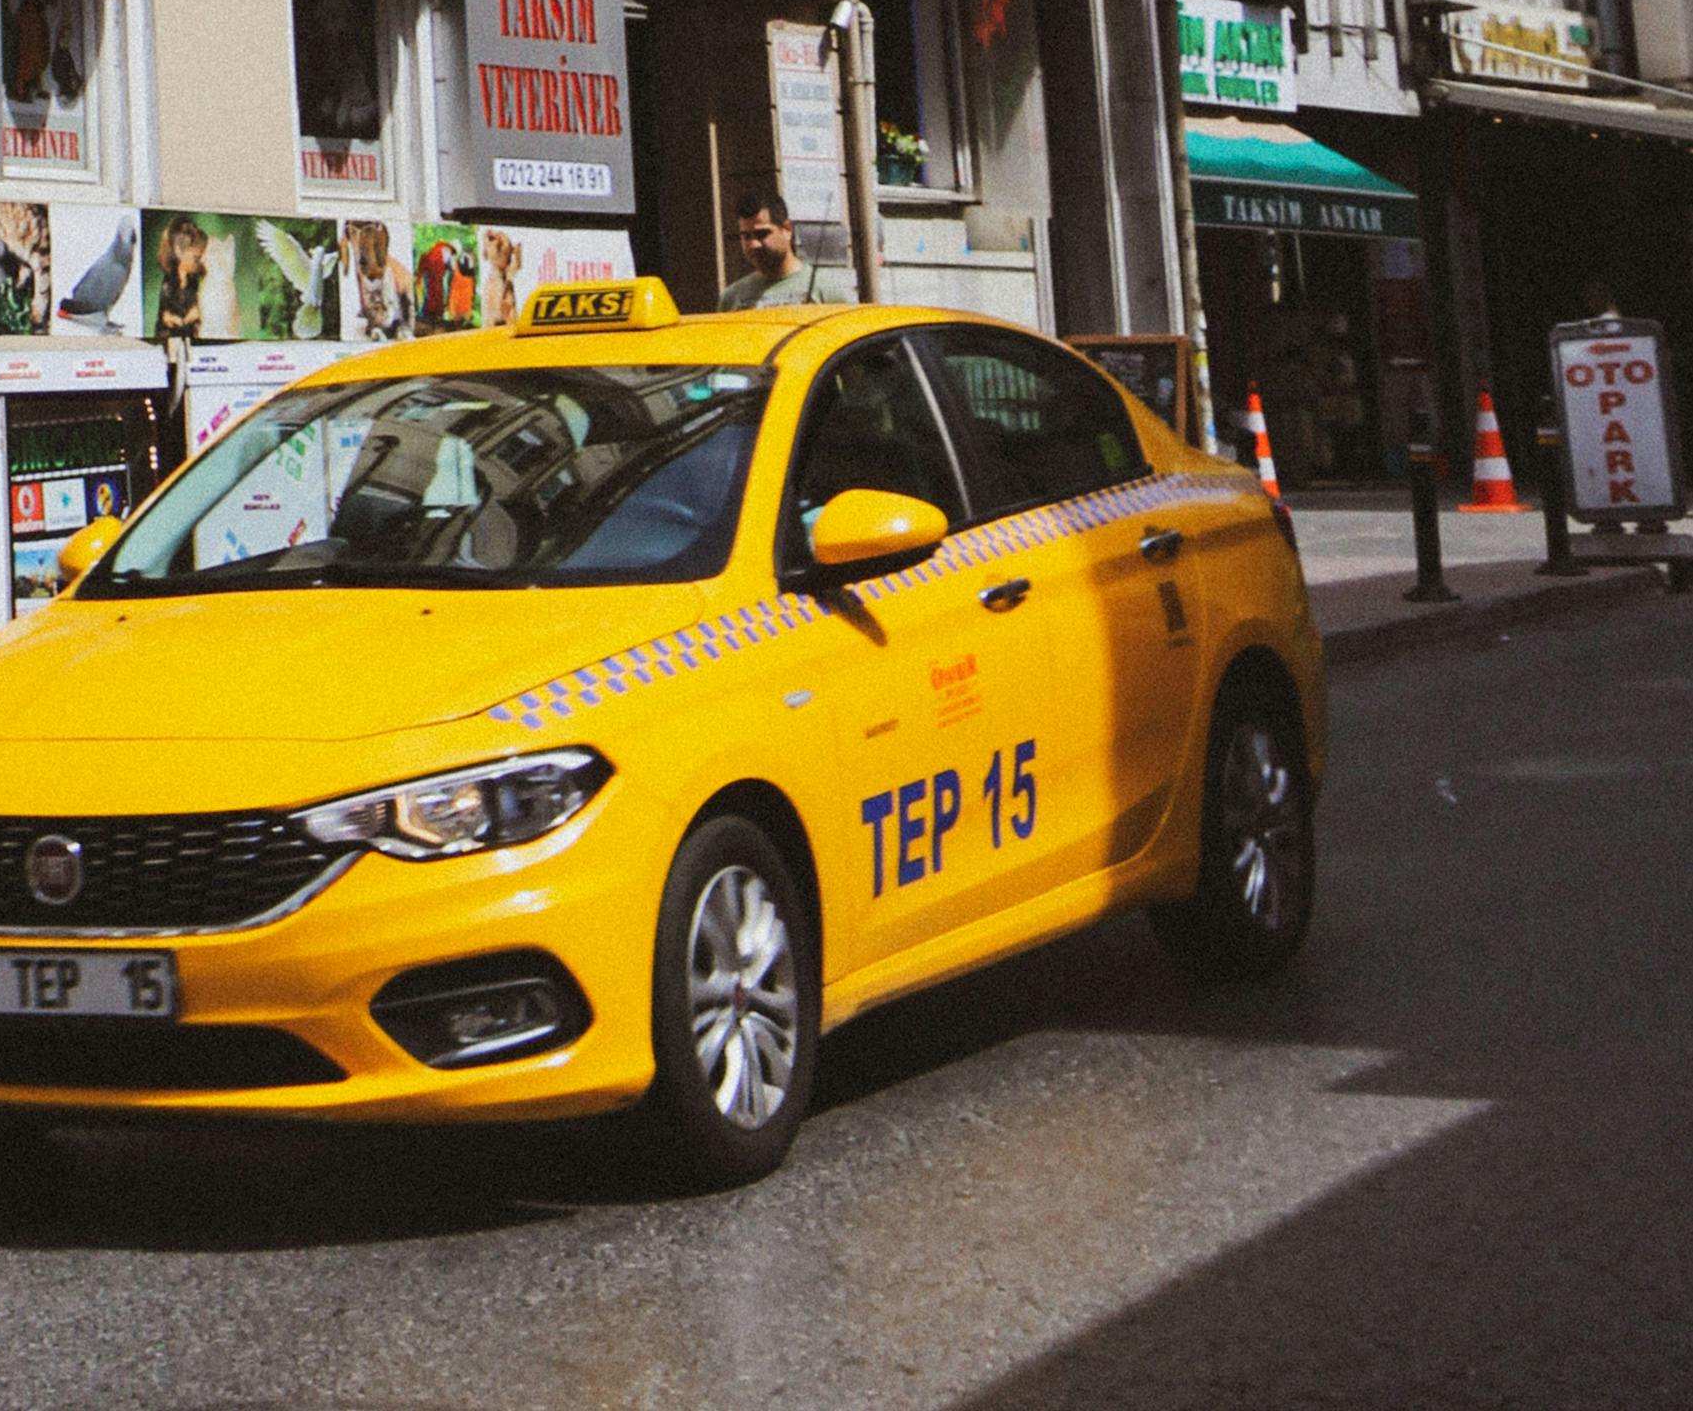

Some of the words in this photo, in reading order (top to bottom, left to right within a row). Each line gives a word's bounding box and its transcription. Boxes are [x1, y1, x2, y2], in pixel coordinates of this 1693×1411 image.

[478, 55, 623, 138] VETERİNER
[499, 162, 534, 186] 0212
[539, 164, 564, 185] 244
[568, 166, 584, 189] 16
[588, 167, 605, 190] 91
[1564, 359, 1655, 388] OTO
[1597, 390, 1642, 504] PARK
[861, 768, 962, 900] TEP
[984, 738, 1037, 850] 15
[11, 959, 82, 1009] TEP
[123, 960, 164, 1010] 15
